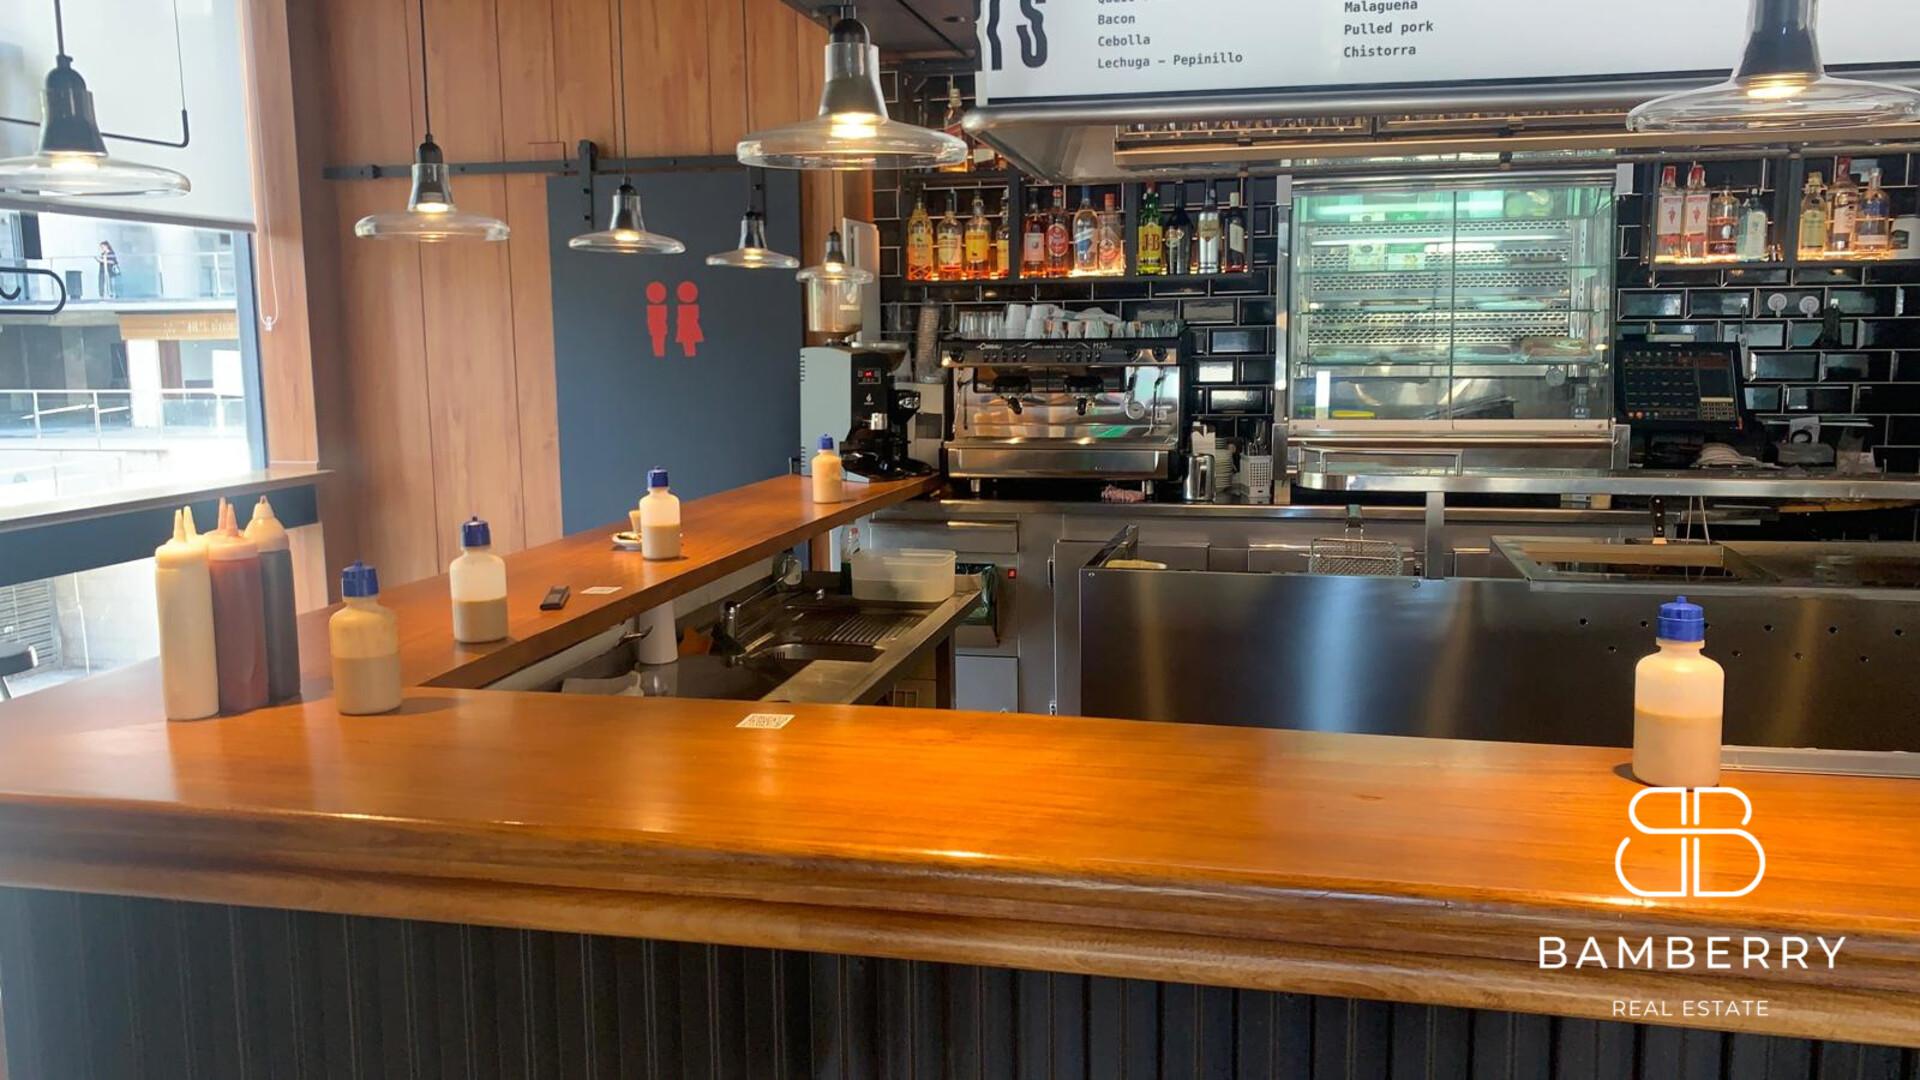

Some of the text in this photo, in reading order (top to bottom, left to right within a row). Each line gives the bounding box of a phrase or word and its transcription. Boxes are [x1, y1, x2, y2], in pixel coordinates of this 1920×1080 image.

[1097, 14, 1136, 25] Bacon
[1344, 20, 1434, 35] Pulled pork
[1097, 34, 1151, 46] Cebolla
[1344, 45, 1416, 58] Chistorra
[1097, 56, 1150, 70] Lechuga
[1173, 52, 1243, 67] Pepinillo
